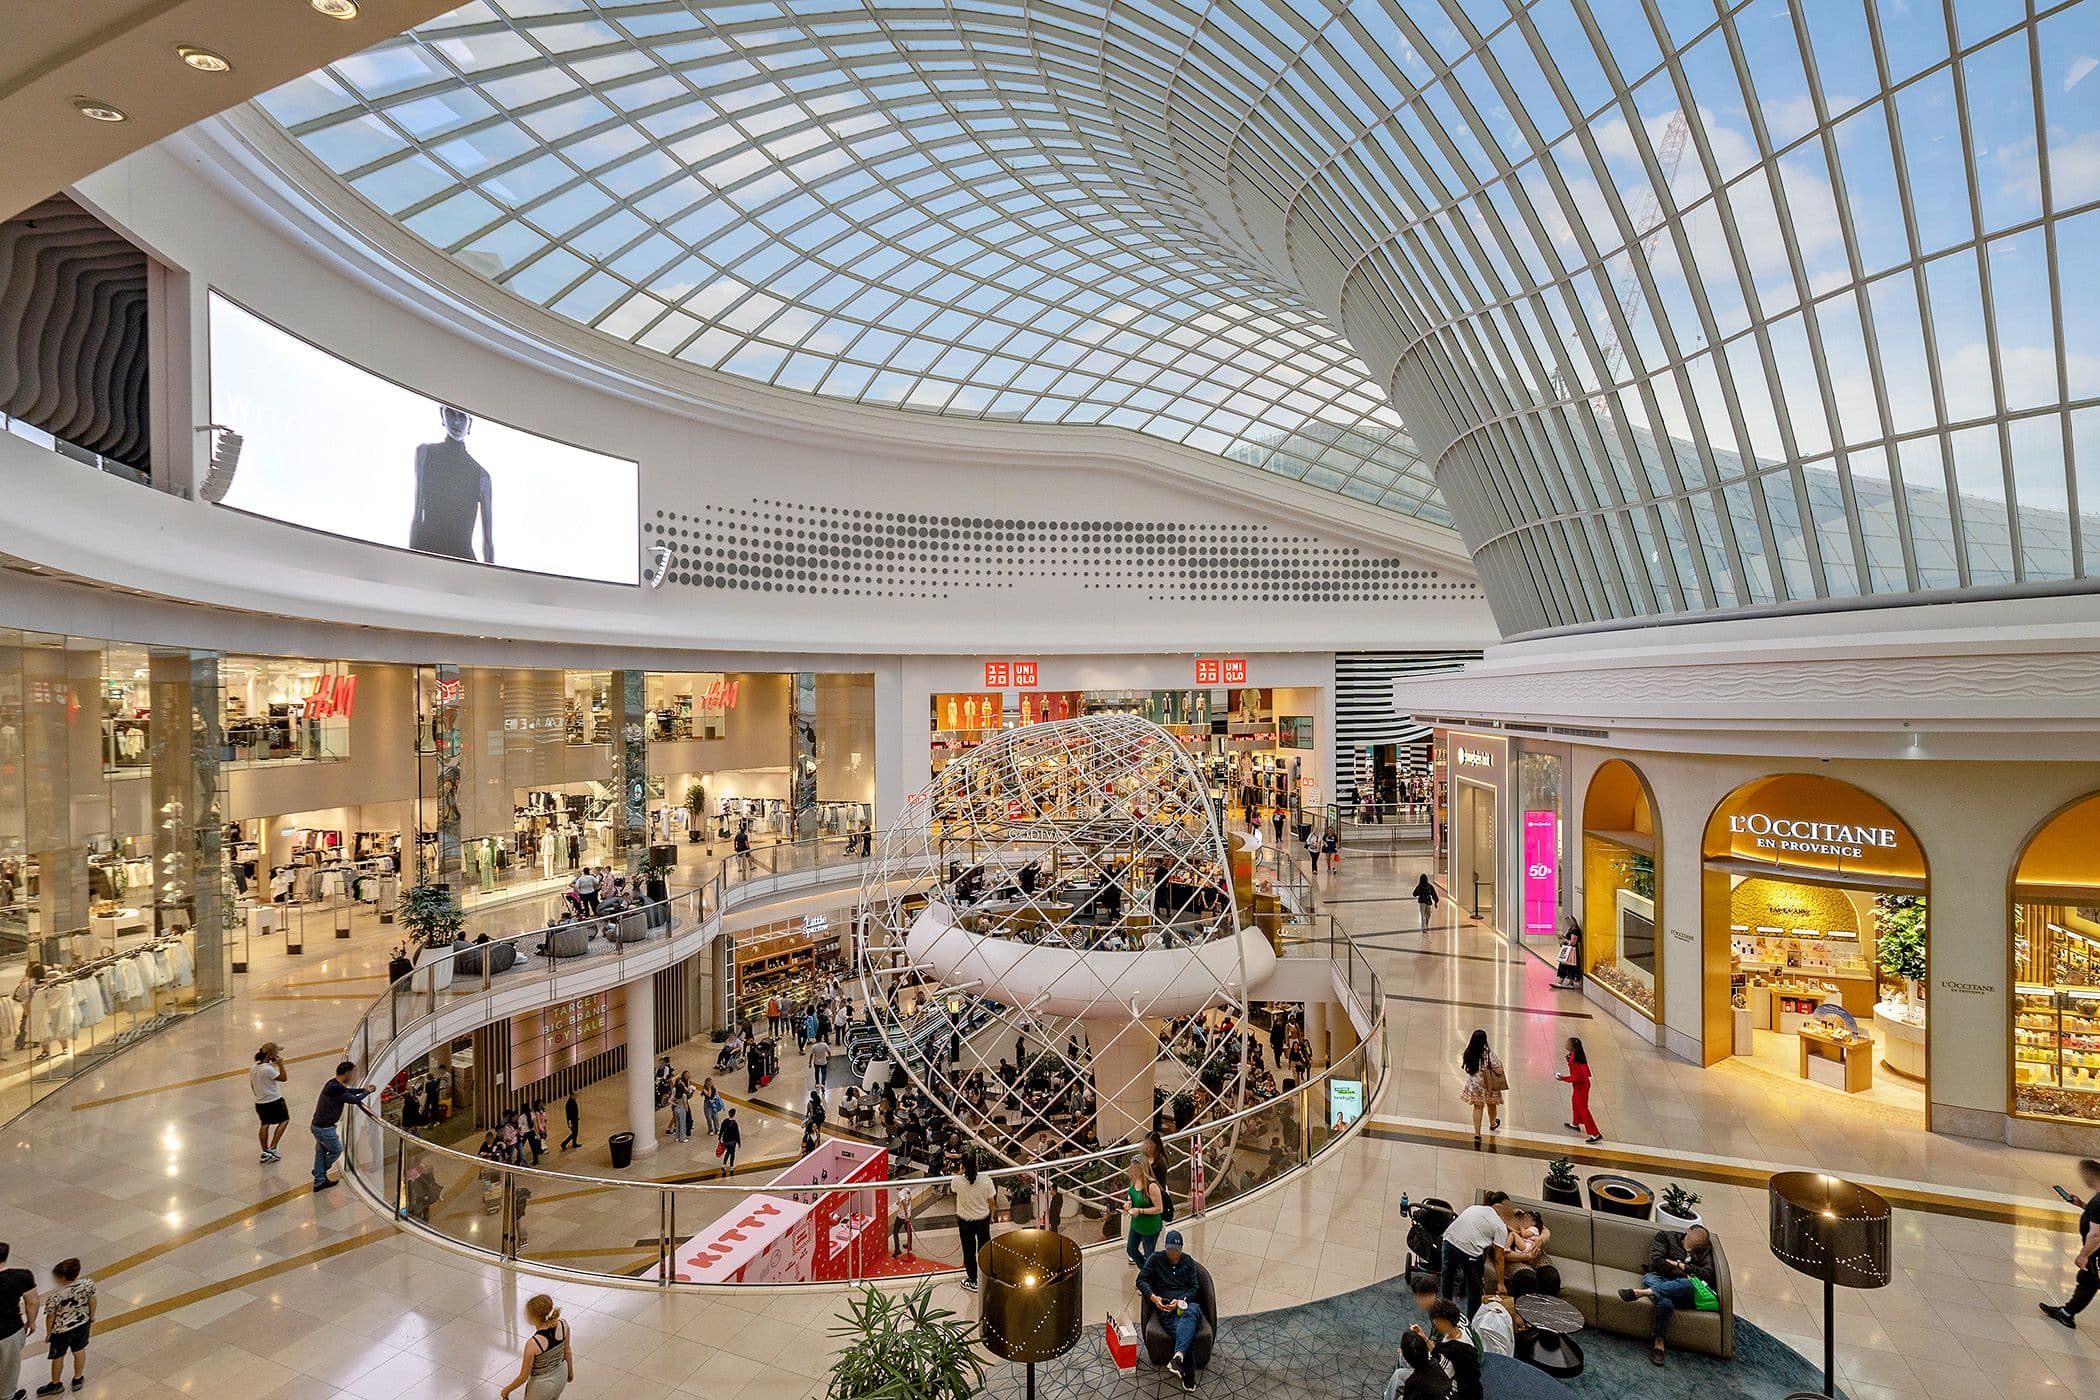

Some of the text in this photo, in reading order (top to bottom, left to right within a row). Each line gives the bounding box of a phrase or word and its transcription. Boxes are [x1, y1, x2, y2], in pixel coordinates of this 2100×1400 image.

[1016, 665, 1034, 674] UNI
[1226, 662, 1242, 671] UNI
[1226, 672, 1244, 681] QLO
[1016, 675, 1035, 685] QLO
[303, 675, 357, 720] H&M
[701, 681, 740, 710] H&M
[1729, 813, 1897, 848] L'OCCITANE
[1756, 838, 1862, 858] EN PROVENCE
[552, 995, 599, 1018] TARGET
[542, 1020, 563, 1035] BIG
[546, 1017, 606, 1047] TOY SALE
[687, 1203, 781, 1268] KITTY
